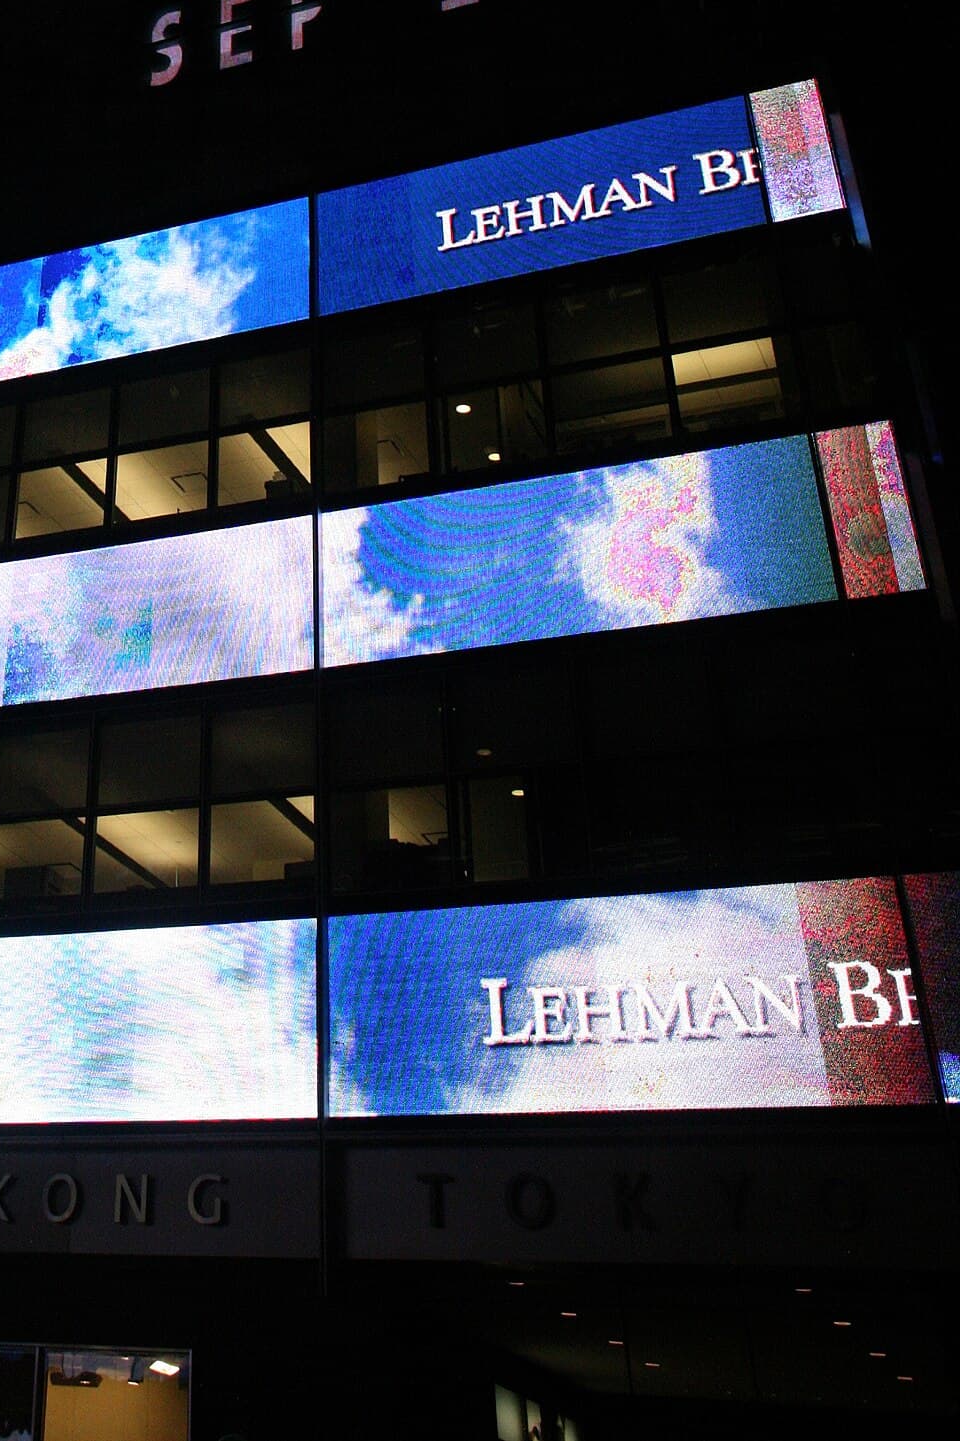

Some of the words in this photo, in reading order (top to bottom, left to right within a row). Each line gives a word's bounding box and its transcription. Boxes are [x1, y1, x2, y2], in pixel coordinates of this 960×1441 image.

[435, 164, 678, 252] LEHMAN
[480, 973, 810, 1048] LEHMAN
[415, 1171, 876, 1233] TOKYO
